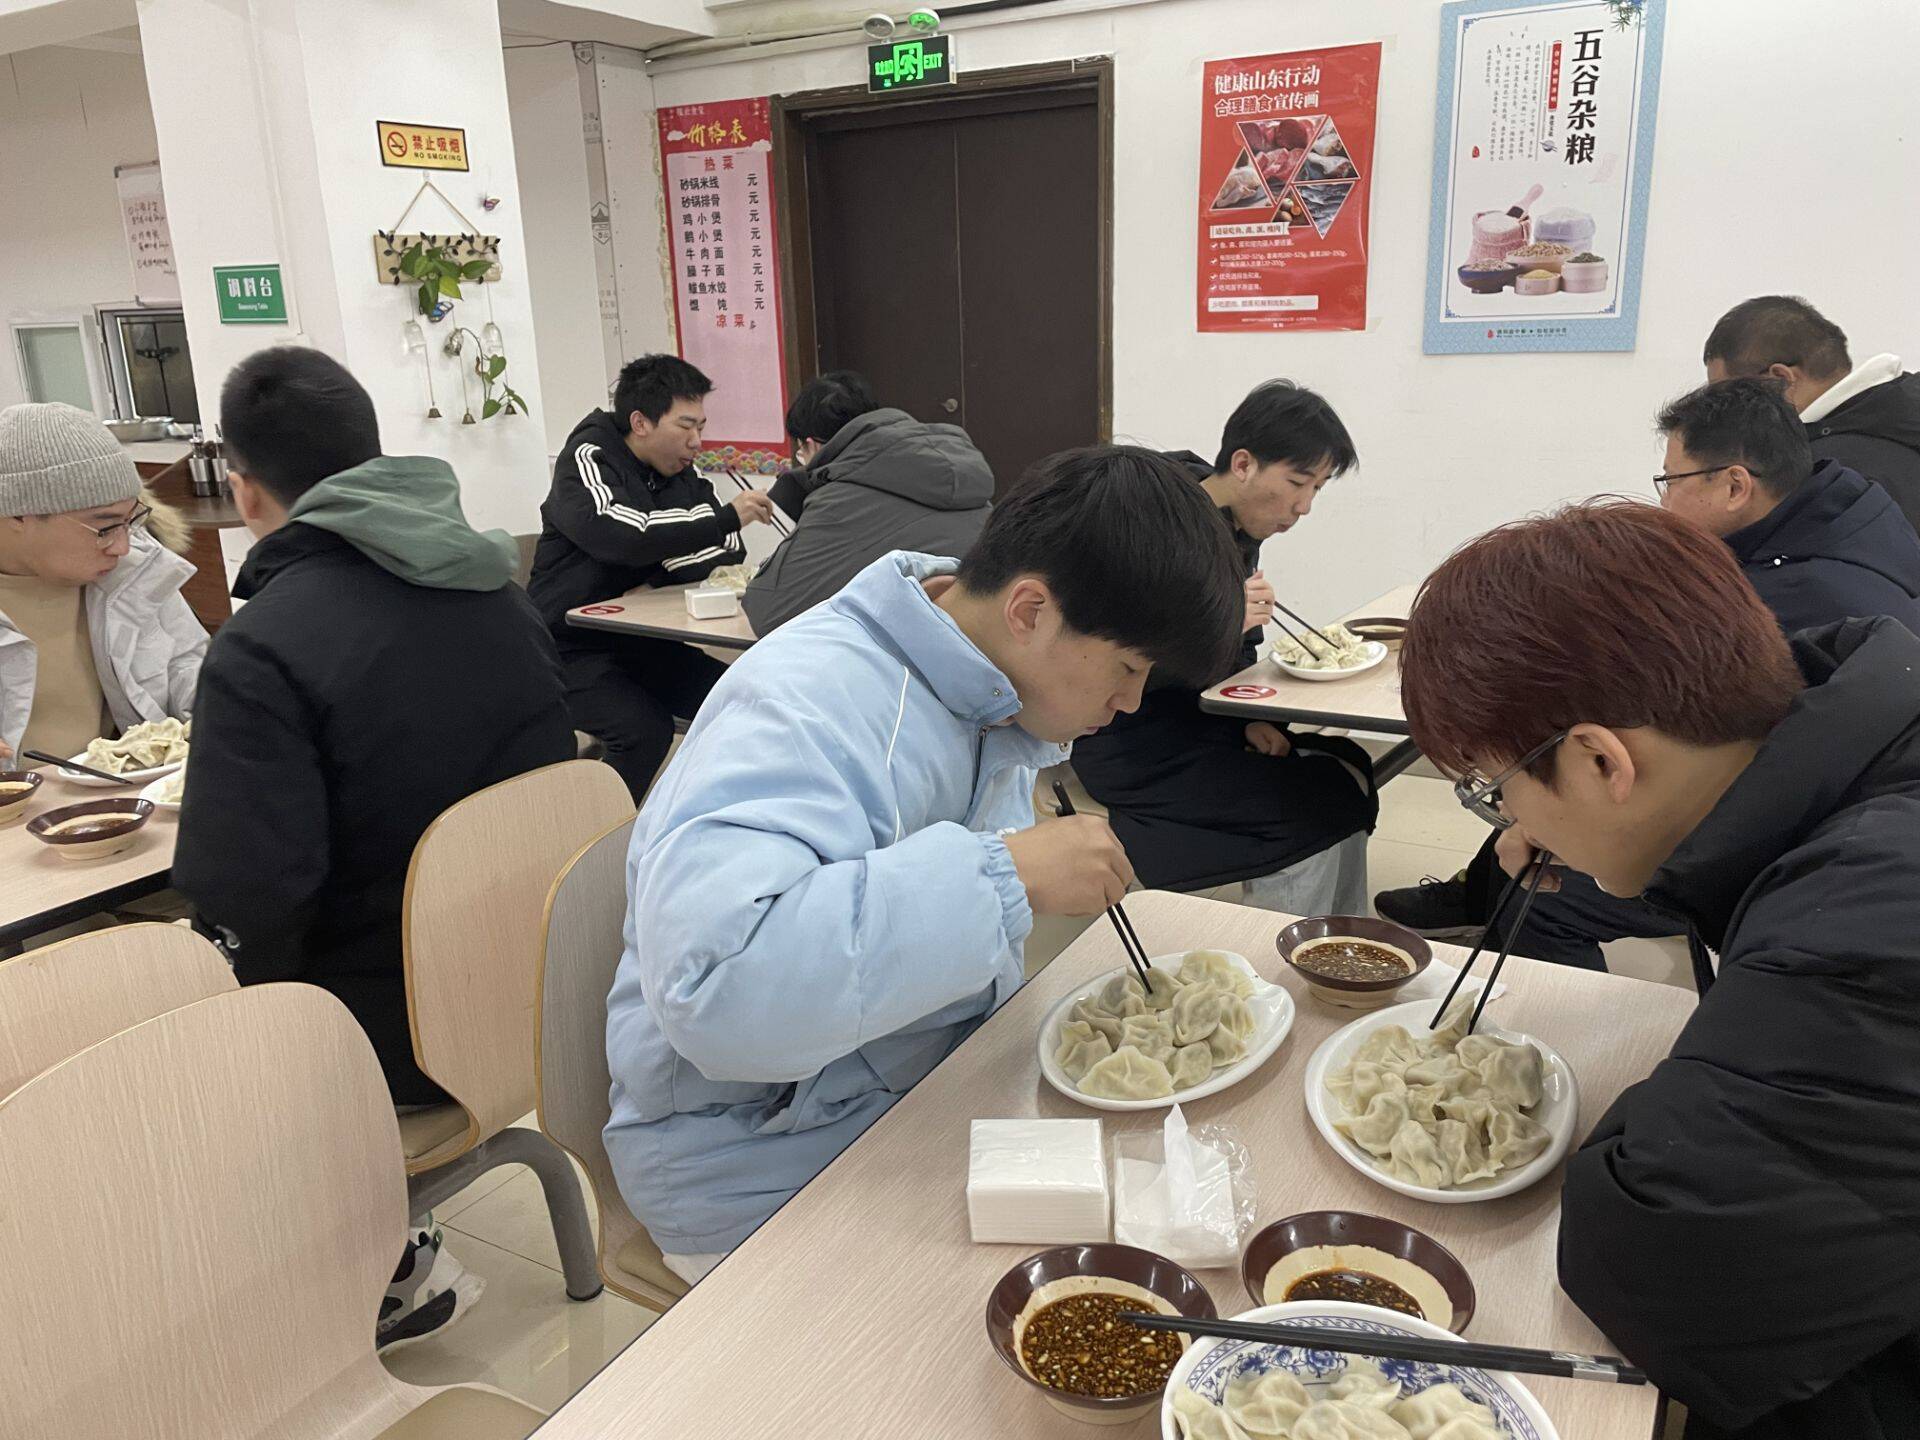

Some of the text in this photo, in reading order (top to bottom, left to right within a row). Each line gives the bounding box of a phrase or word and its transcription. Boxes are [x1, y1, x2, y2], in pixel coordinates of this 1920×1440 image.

[923, 52, 943, 70] EXIT
[1214, 64, 1321, 95] 健康山东行动
[1214, 90, 1320, 117] 合理膳食宣传画
[1564, 29, 1604, 165] 五谷杂粮
[686, 118, 748, 148] 价格表
[412, 134, 461, 154] 禁止吸烟
[427, 153, 462, 162] SMOKING
[704, 155, 734, 172] 热菜
[680, 173, 758, 191] 砂锅米线 元
[681, 191, 759, 209] 砂锅排骨 元
[682, 209, 760, 226] 鸡小煲 元
[751, 227, 761, 240] 元
[686, 245, 762, 260] 牛肉面 元
[753, 263, 763, 275] 元
[754, 280, 765, 293] 元
[754, 298, 765, 310] 元
[716, 313, 745, 328] 凉菜
